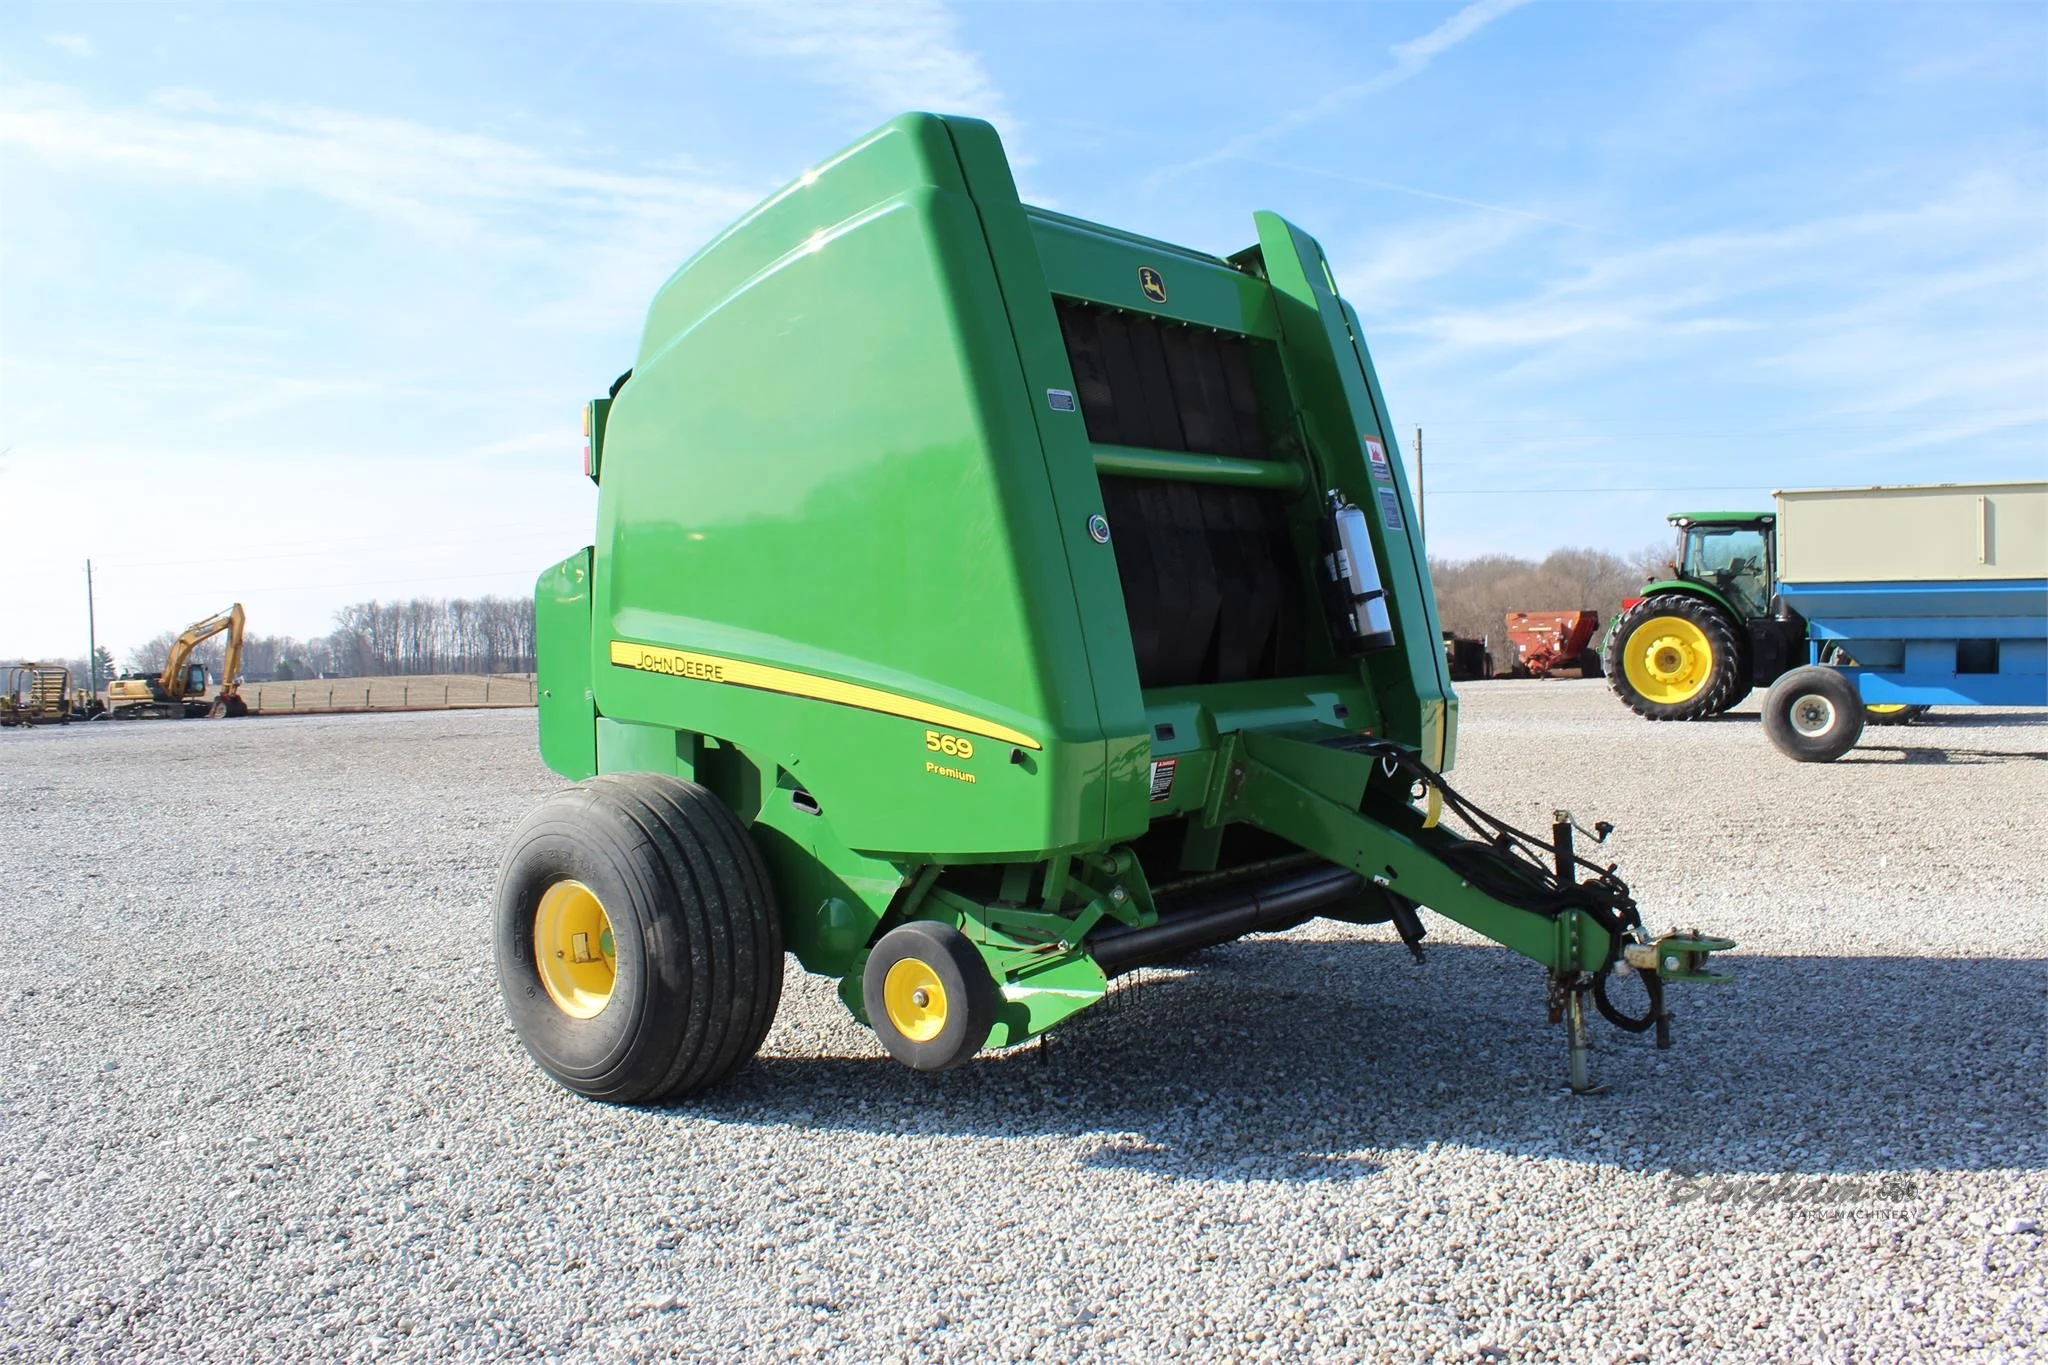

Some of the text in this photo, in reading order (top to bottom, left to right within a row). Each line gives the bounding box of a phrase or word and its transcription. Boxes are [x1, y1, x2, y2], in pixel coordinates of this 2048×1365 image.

[638, 651, 723, 679] JOHN DEERE
[926, 730, 973, 759] 569
[926, 762, 976, 783] Premium
